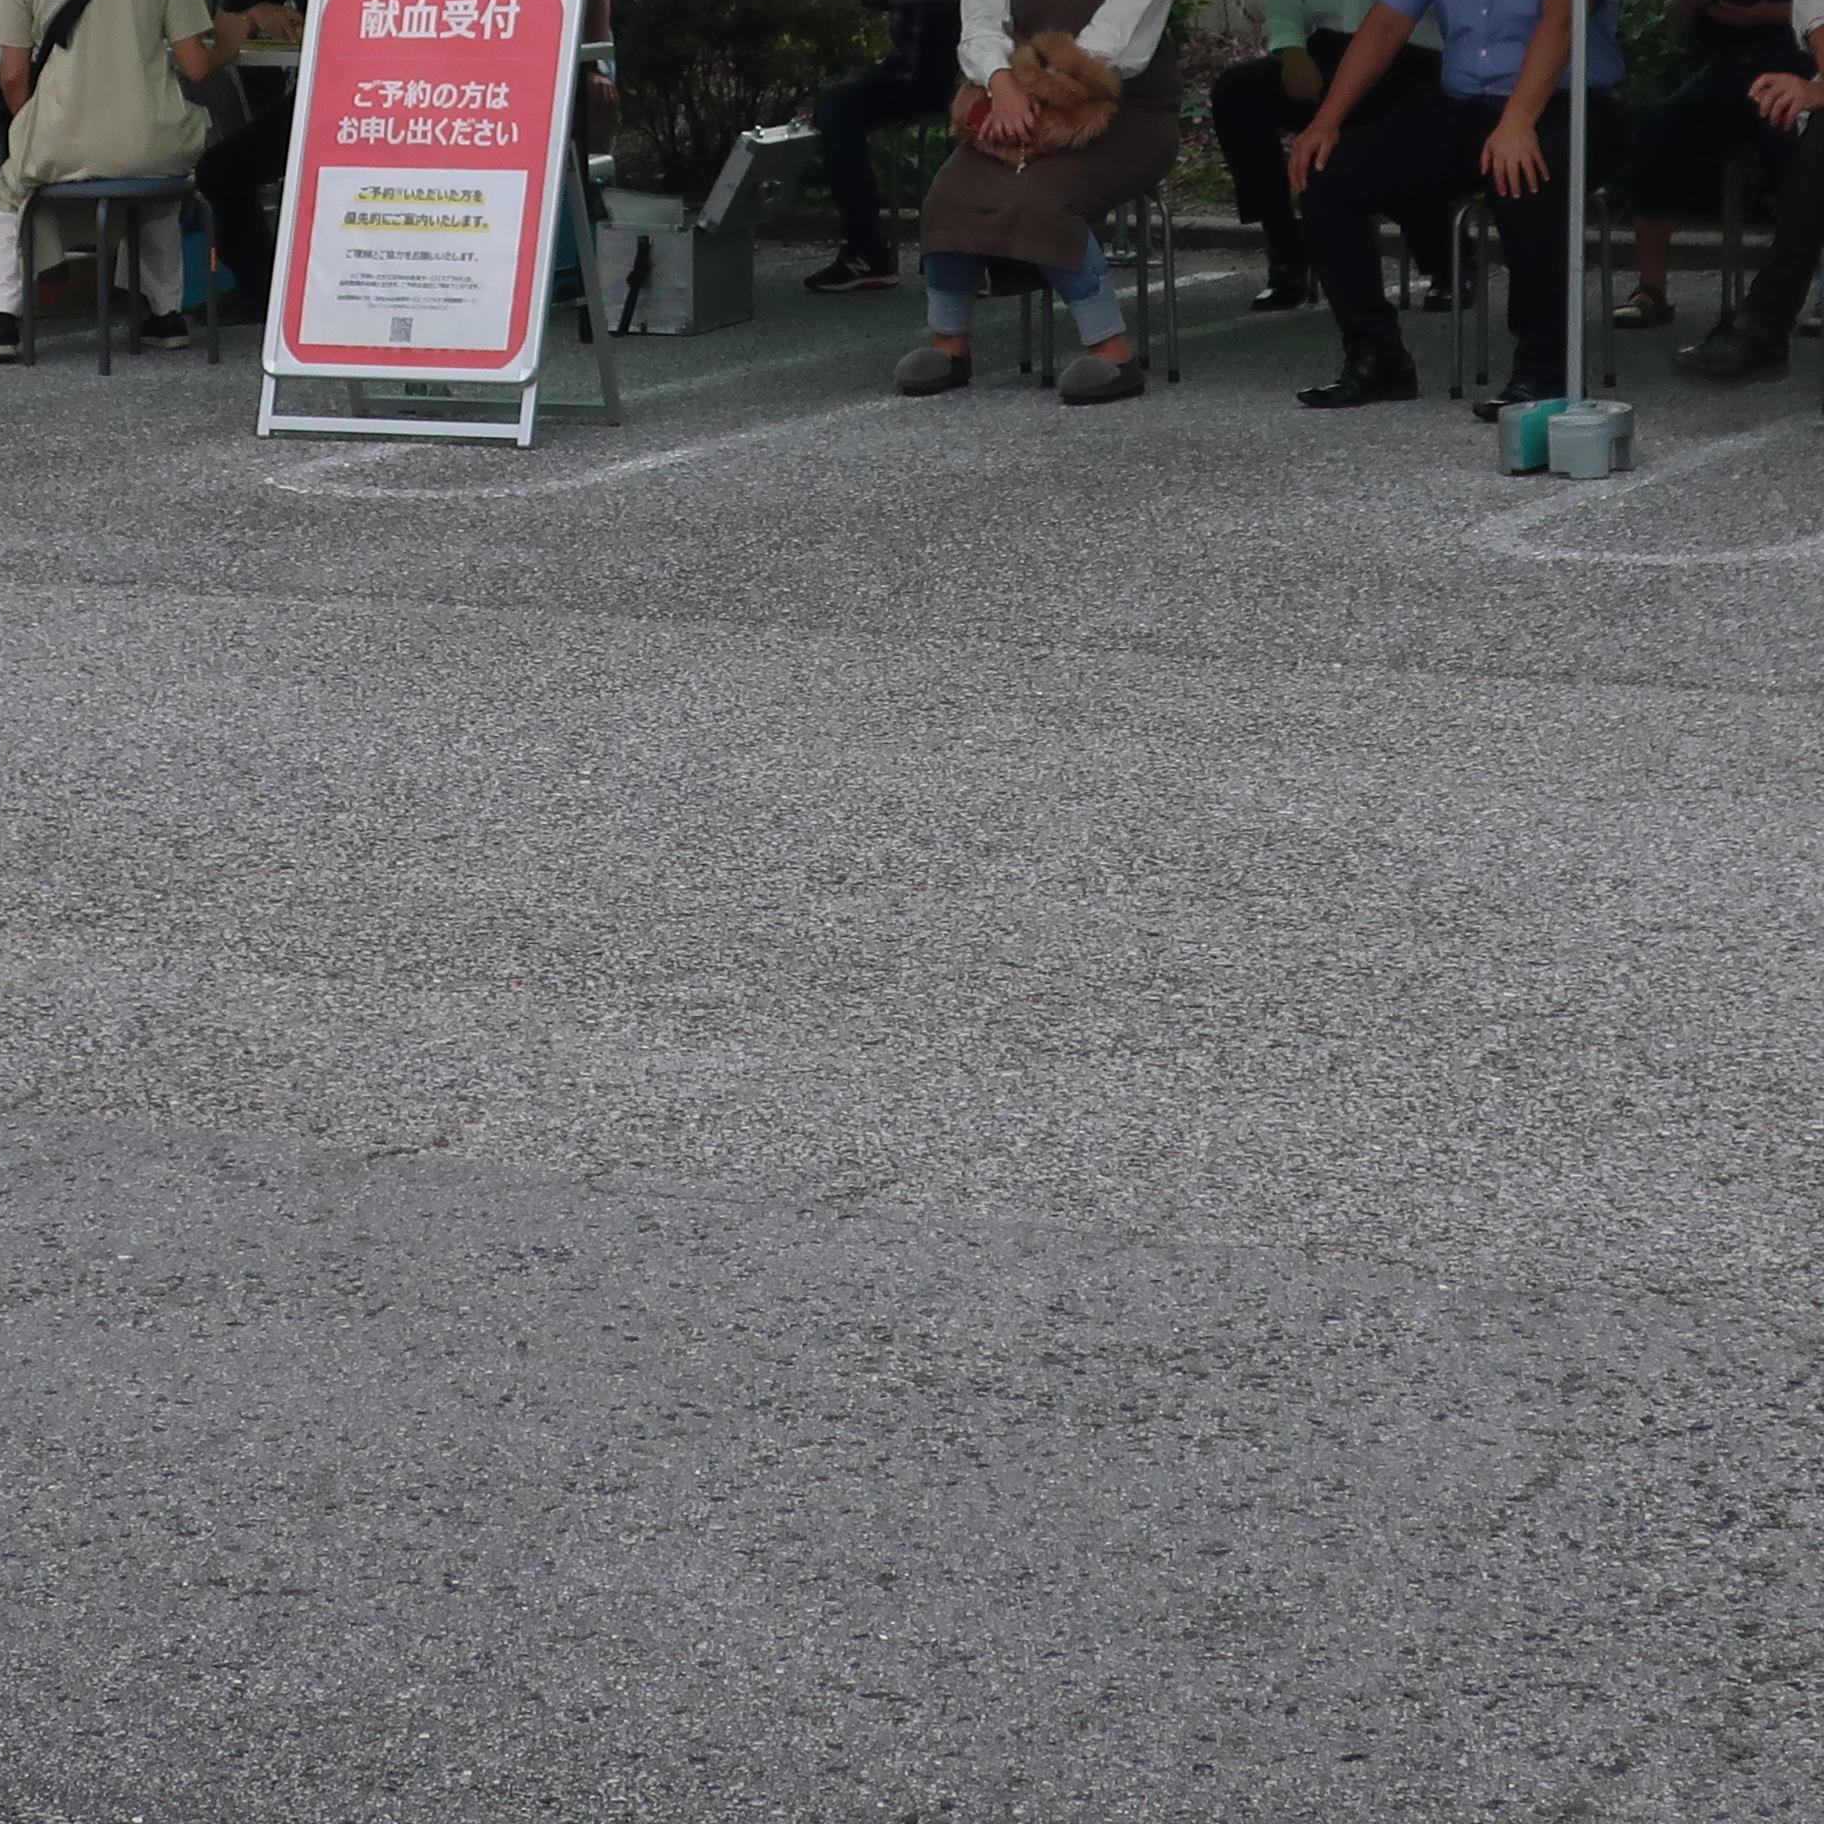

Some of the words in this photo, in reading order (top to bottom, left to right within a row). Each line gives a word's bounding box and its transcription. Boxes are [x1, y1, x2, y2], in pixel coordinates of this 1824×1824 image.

[354, 80, 510, 109] ご予約の方は
[336, 115, 519, 146] お申し出ください
